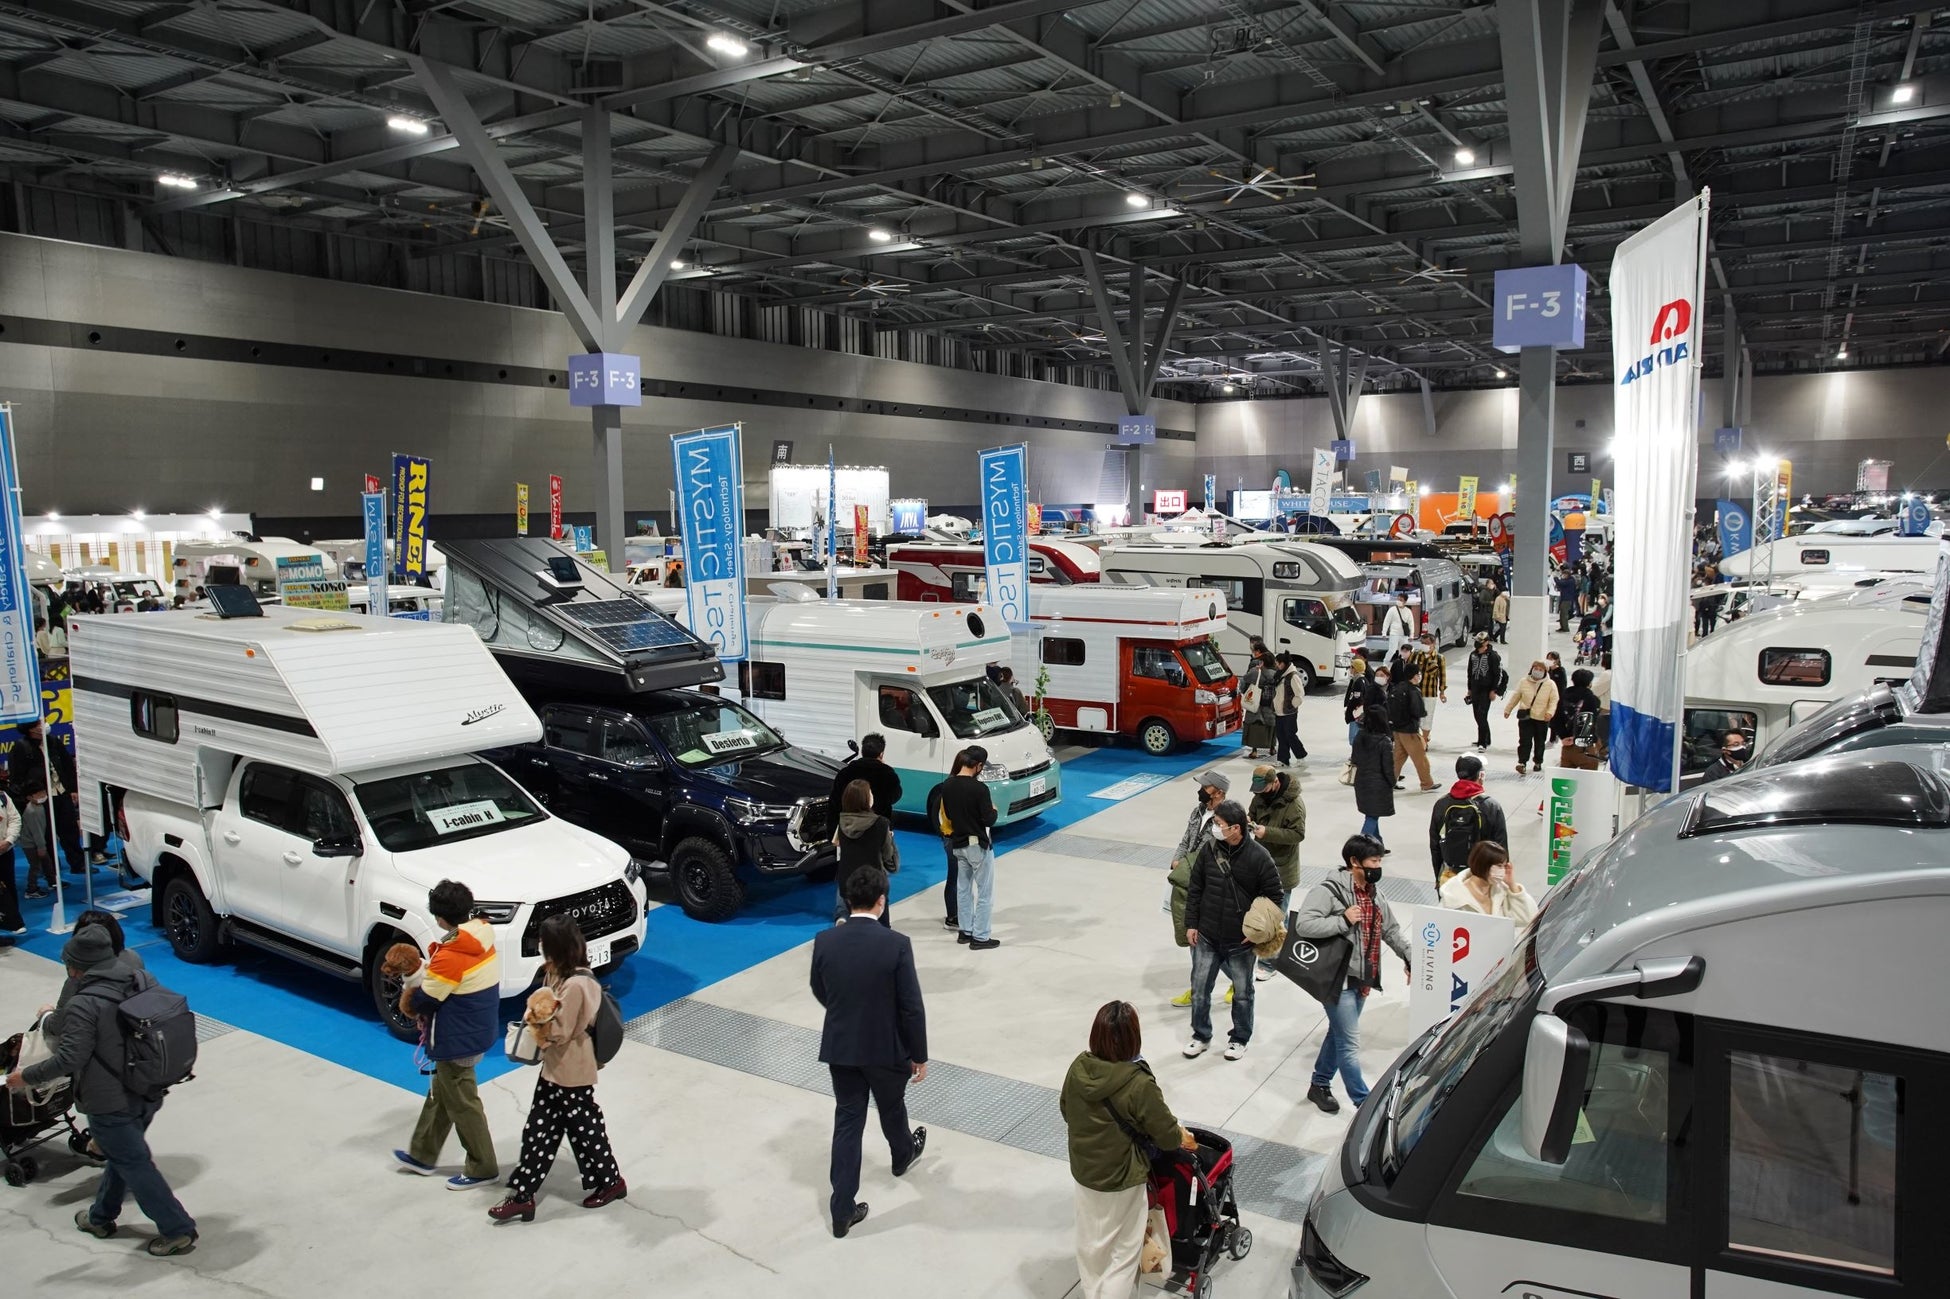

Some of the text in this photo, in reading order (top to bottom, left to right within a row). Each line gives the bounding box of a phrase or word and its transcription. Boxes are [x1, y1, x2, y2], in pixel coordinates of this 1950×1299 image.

[1507, 291, 1561, 321] F-3
[574, 370, 599, 389] F-3
[609, 369, 636, 389] F-3
[1122, 424, 1141, 435] F-2
[776, 443, 789, 460] 南
[1312, 470, 1329, 515] TACOS
[1160, 496, 1181, 508] 出口
[1281, 500, 1349, 508] WHIT USE
[406, 460, 428, 575] RINEI
[288, 565, 323, 579] MOMO
[311, 582, 347, 592] MOMO
[711, 736, 751, 751] Desierto
[564, 897, 611, 918] TOYOTA
